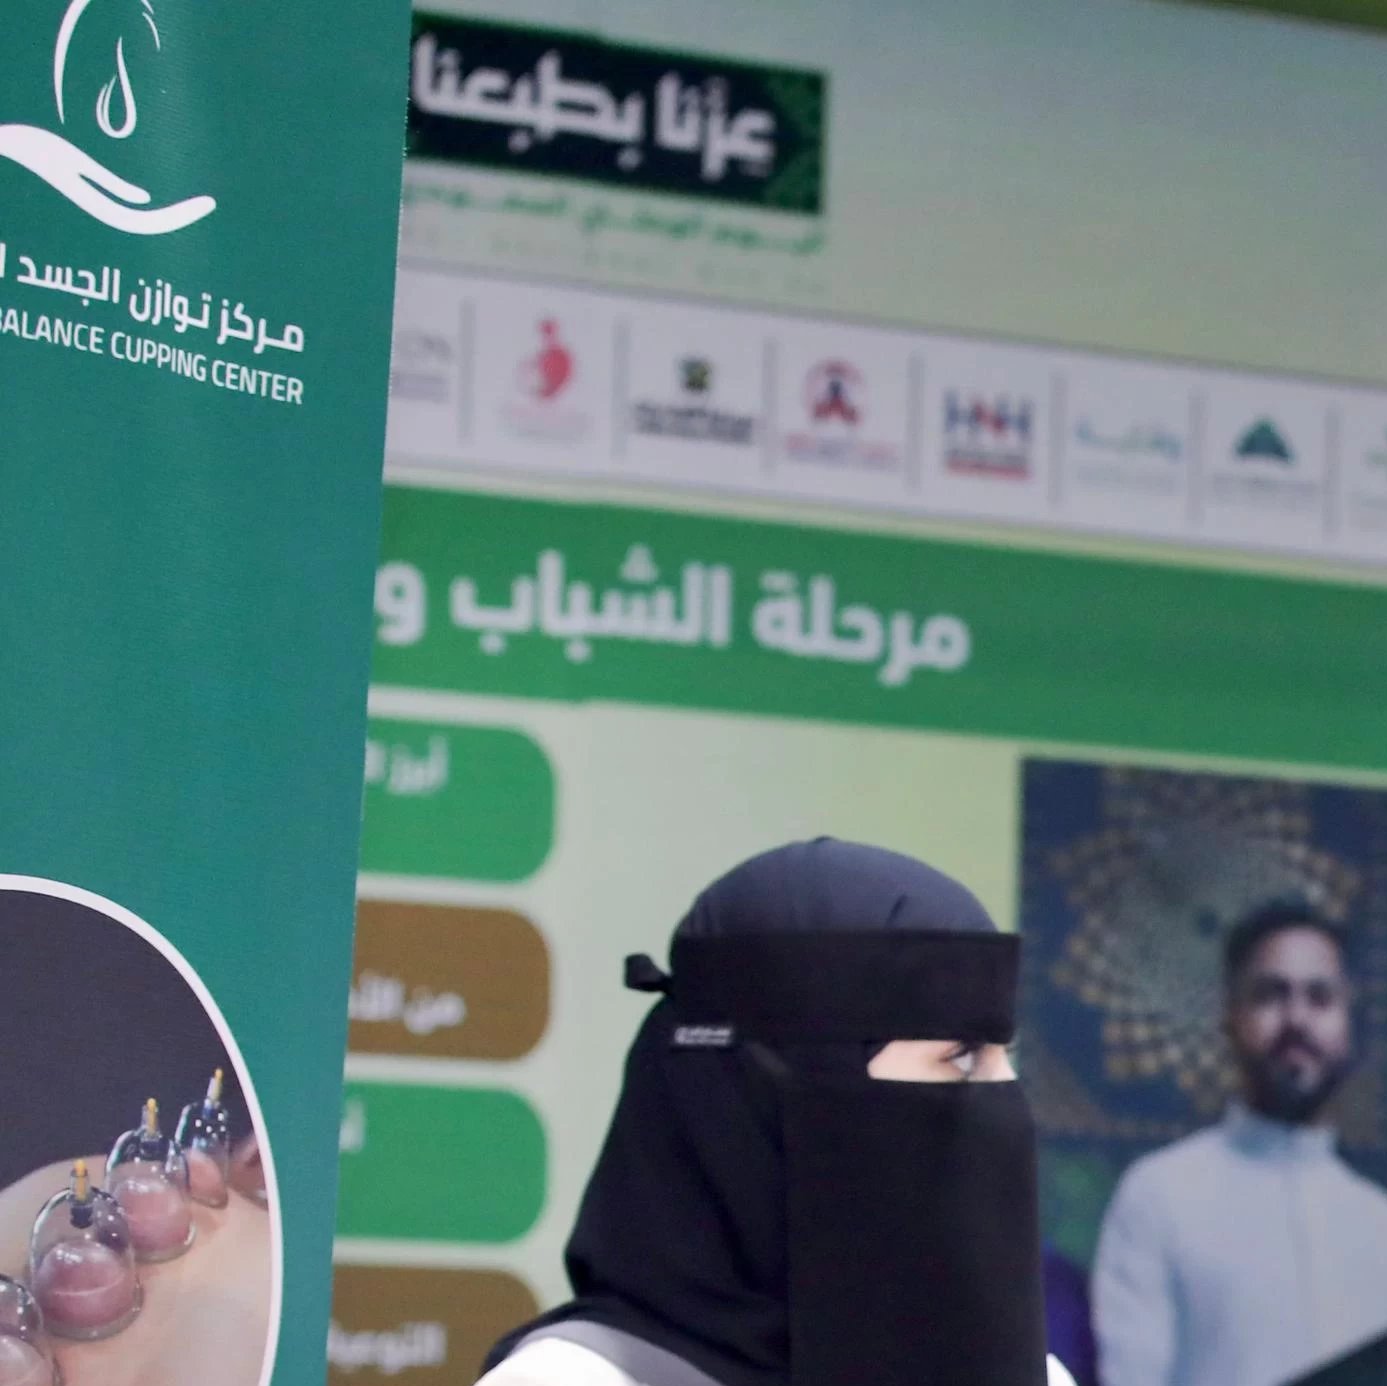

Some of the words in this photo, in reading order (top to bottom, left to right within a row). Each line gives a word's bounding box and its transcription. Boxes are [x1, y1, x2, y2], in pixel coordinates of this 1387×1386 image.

[412, 31, 644, 171] بطبعنا
[17, 255, 121, 307] الجسد
[129, 277, 212, 333] توازن
[217, 297, 304, 354] مركز
[0, 308, 104, 354] ALANCE
[111, 331, 206, 382] CUPPING
[211, 359, 304, 405] CENTER
[449, 544, 732, 663] الشباب
[752, 571, 971, 686] مرحلة
